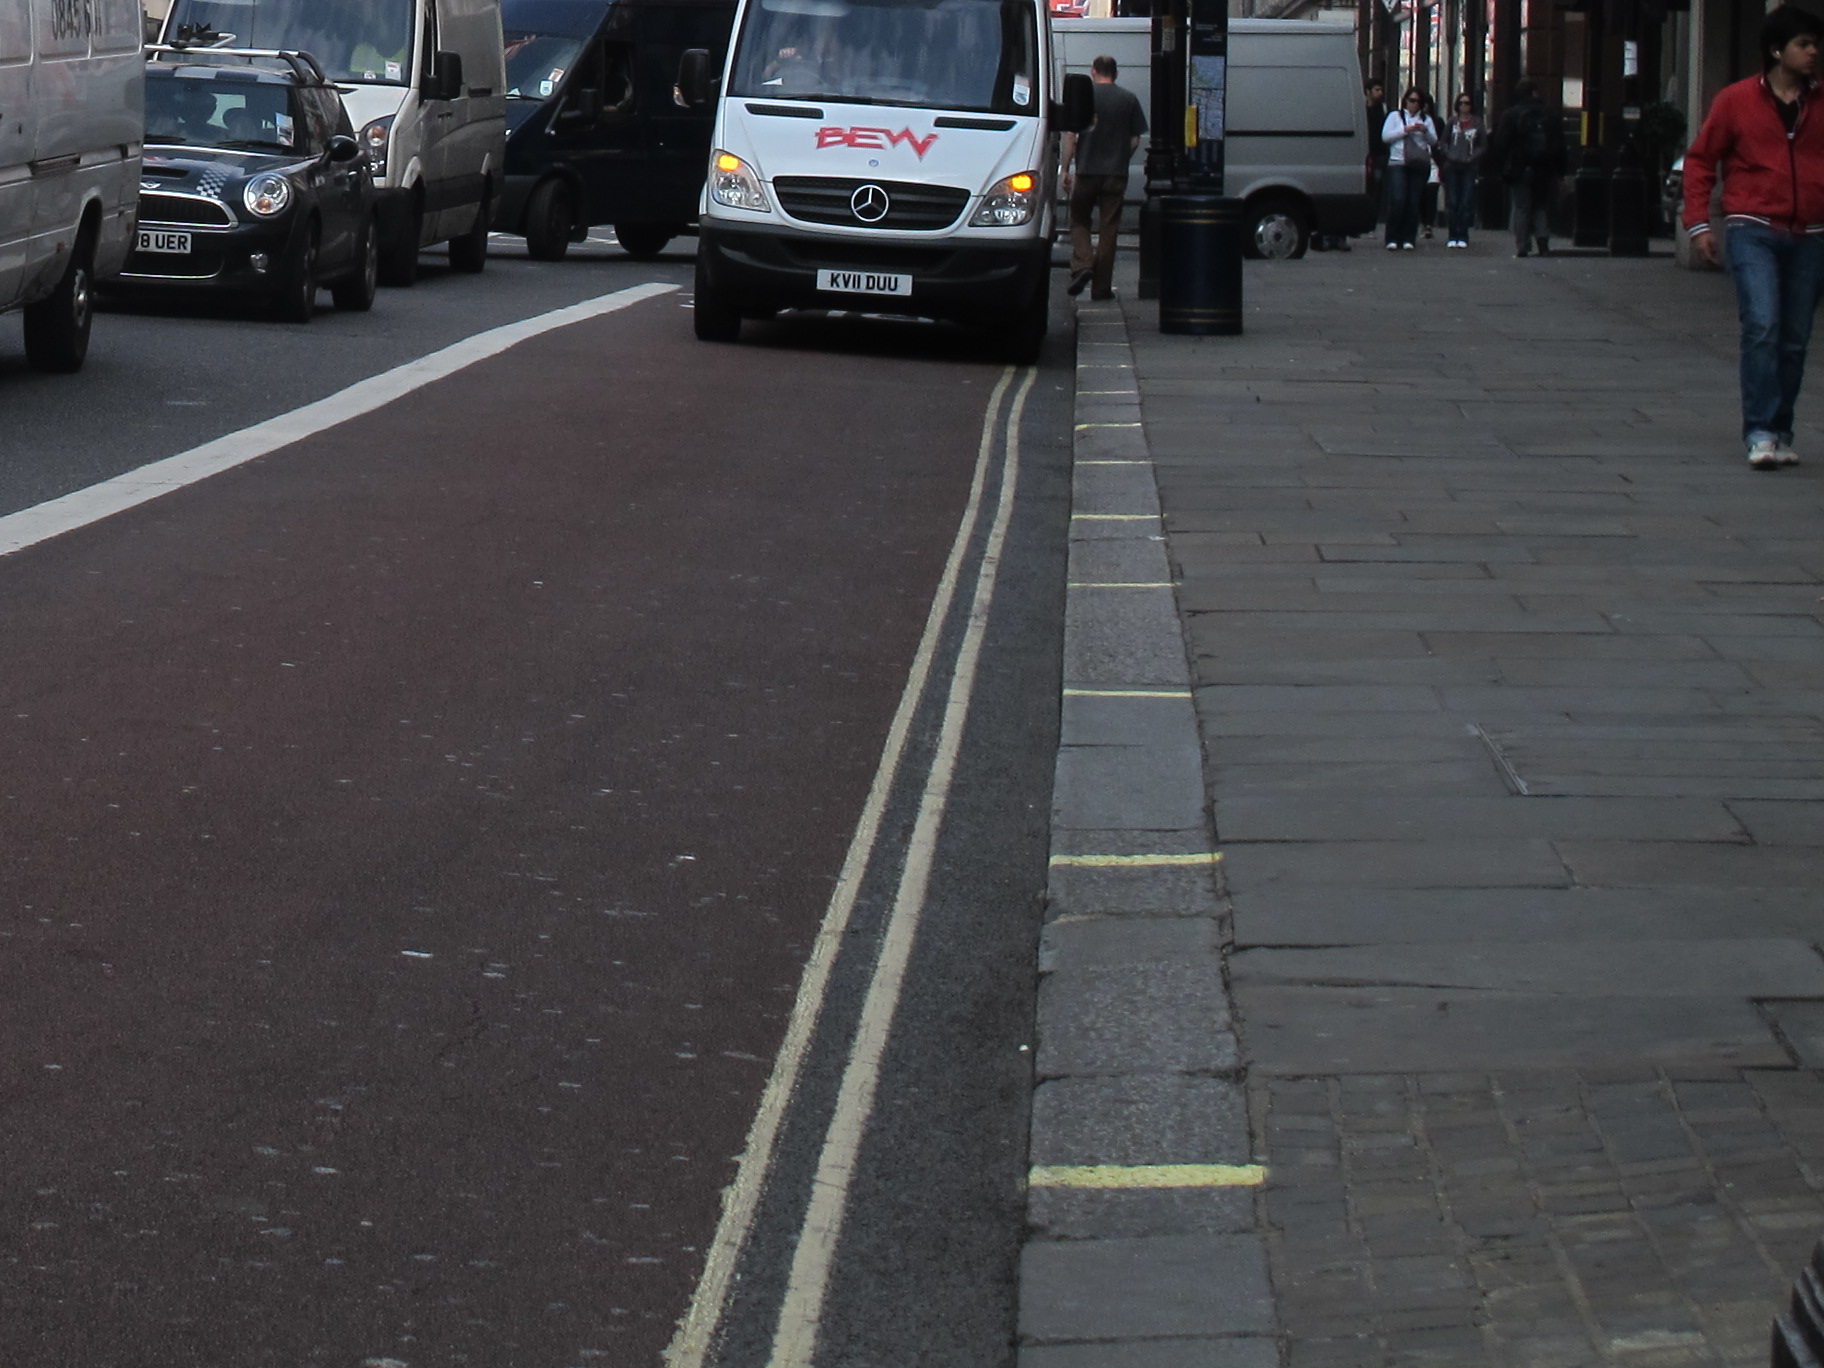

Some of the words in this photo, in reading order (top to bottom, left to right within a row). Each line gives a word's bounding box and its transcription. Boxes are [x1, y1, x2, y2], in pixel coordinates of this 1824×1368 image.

[814, 125, 939, 163] BEW
[155, 234, 188, 250] UER
[830, 273, 861, 290] KV11
[865, 275, 898, 292] DUU
